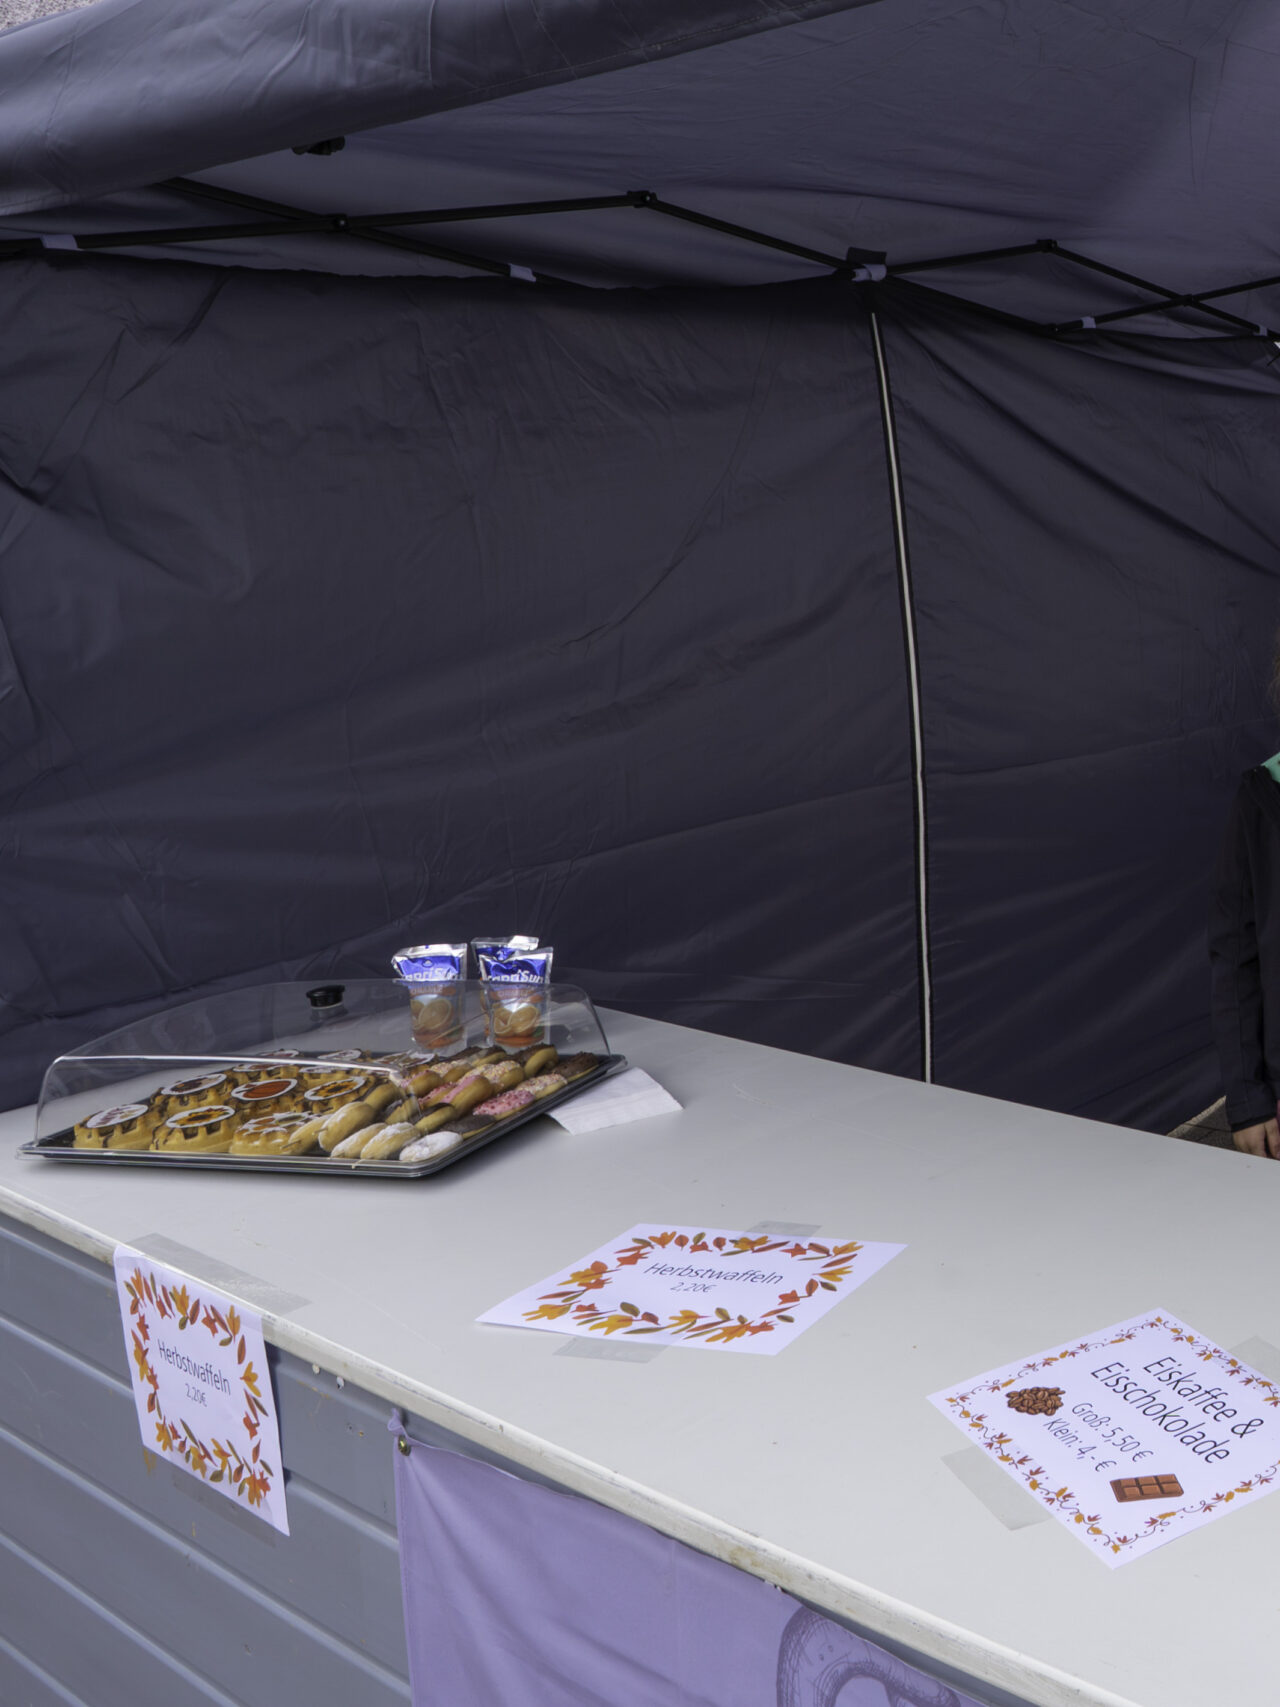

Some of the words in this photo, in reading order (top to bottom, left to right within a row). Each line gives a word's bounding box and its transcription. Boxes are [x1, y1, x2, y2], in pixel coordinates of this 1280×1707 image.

[643, 1262, 784, 1285] Herbstwaffeln
[670, 1281, 718, 1294] 2,20€
[157, 1338, 231, 1396] Herbstwaffeln
[185, 1383, 207, 1408] 2,20€
[1143, 1356, 1237, 1423] Eiskaffee
[1230, 1418, 1264, 1438] &
[1071, 1402, 1111, 1431] Groß:
[1090, 1361, 1230, 1464] Eisschokolade
[1043, 1418, 1083, 1448] Klein:
